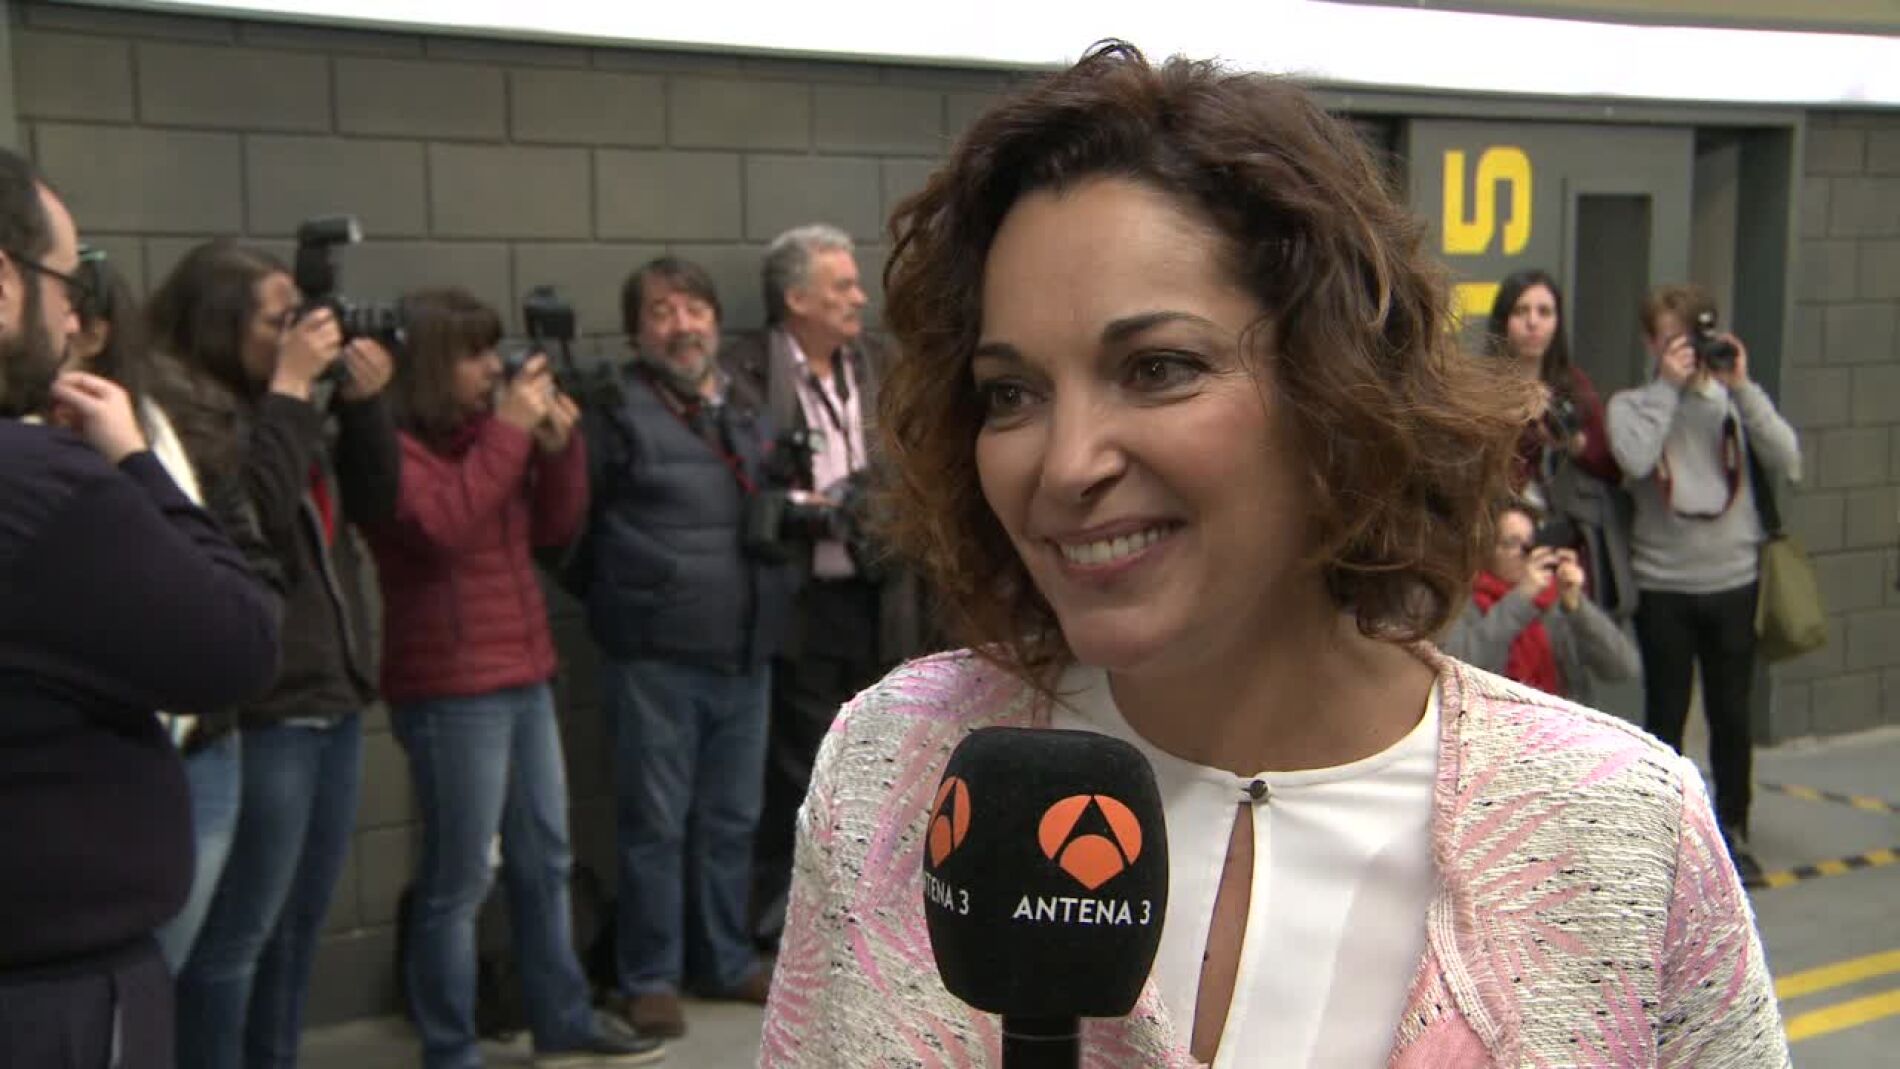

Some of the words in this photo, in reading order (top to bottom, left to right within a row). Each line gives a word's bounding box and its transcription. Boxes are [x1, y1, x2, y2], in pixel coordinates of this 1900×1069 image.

[924, 872, 954, 911] TENA
[959, 889, 970, 915] 3
[1012, 894, 1133, 926] ANTENA
[1139, 899, 1152, 926] 3
